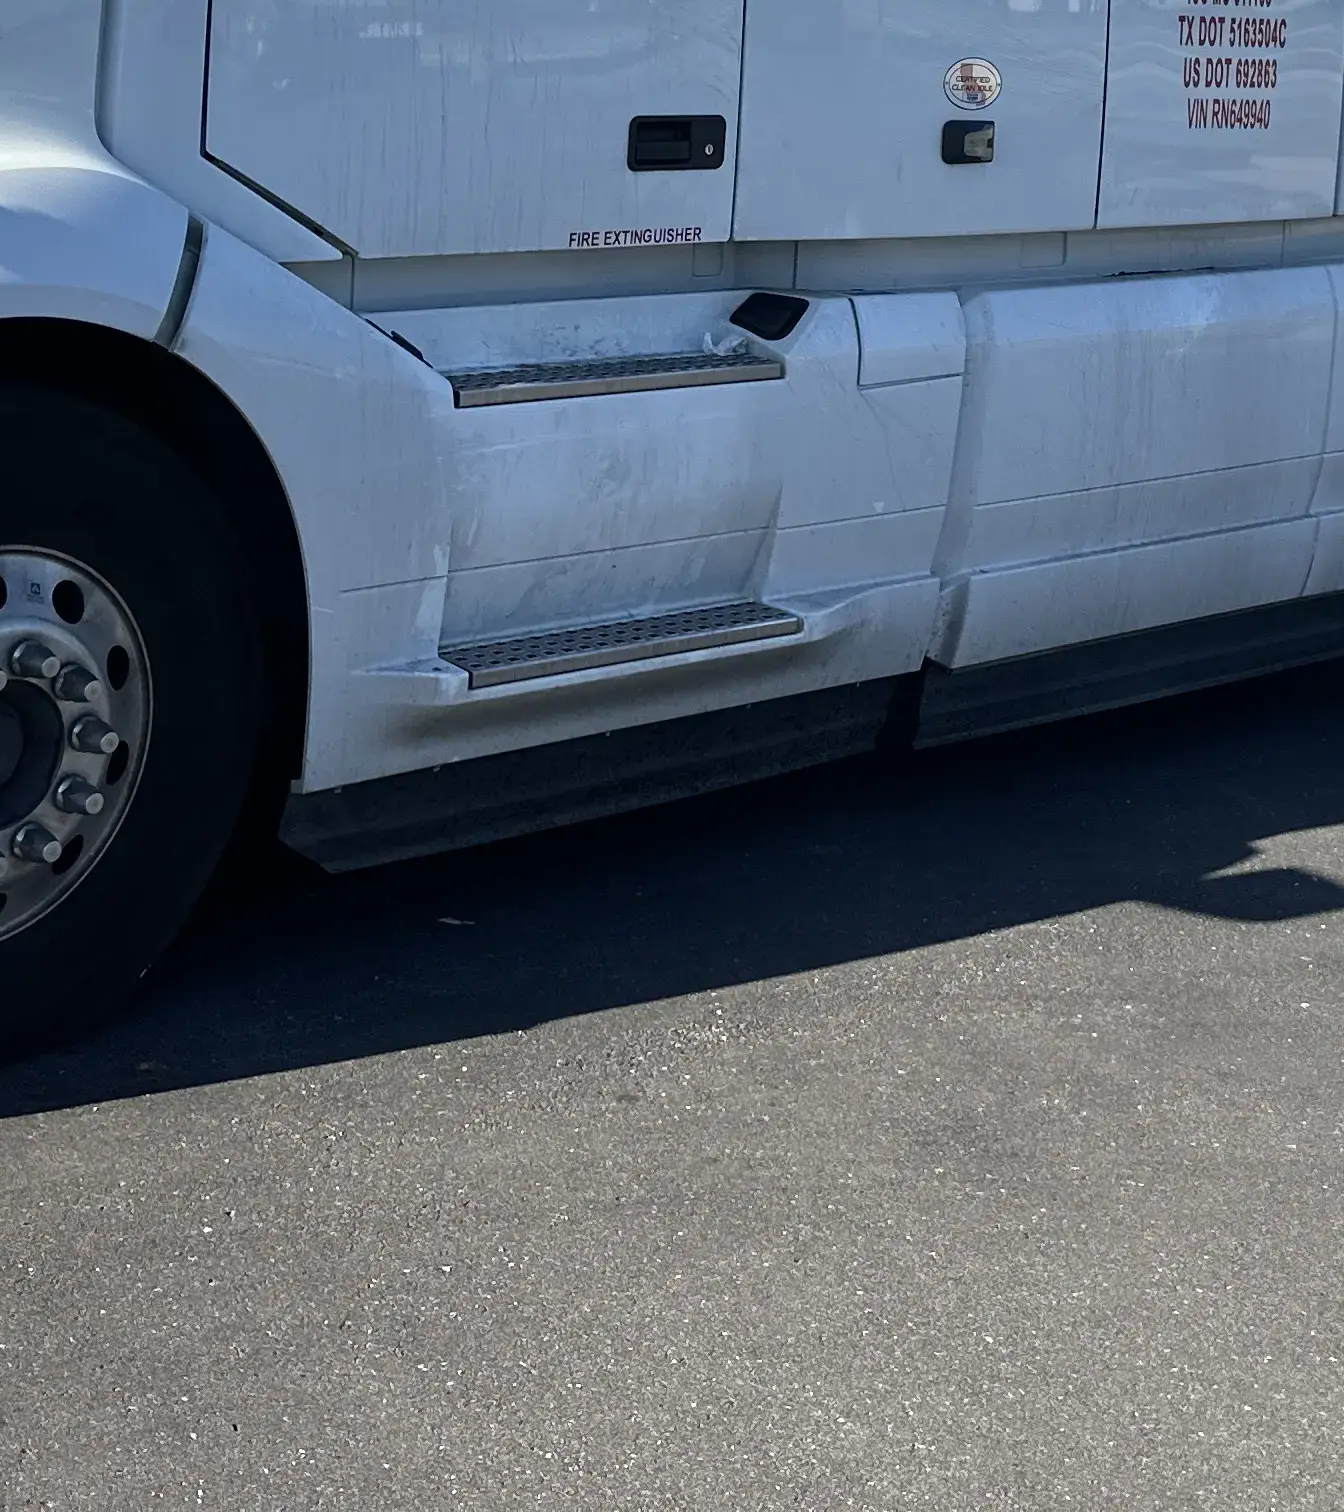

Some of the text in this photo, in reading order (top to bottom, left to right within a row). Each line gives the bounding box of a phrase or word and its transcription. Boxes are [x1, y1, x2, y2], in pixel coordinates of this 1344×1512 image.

[1178, 15, 1287, 49] TX DOT 5163504C
[1183, 56, 1278, 89] US DOT 692863
[1187, 97, 1271, 130] VIN RN649940
[568, 226, 702, 248] FIRE EXTINGUISHER
